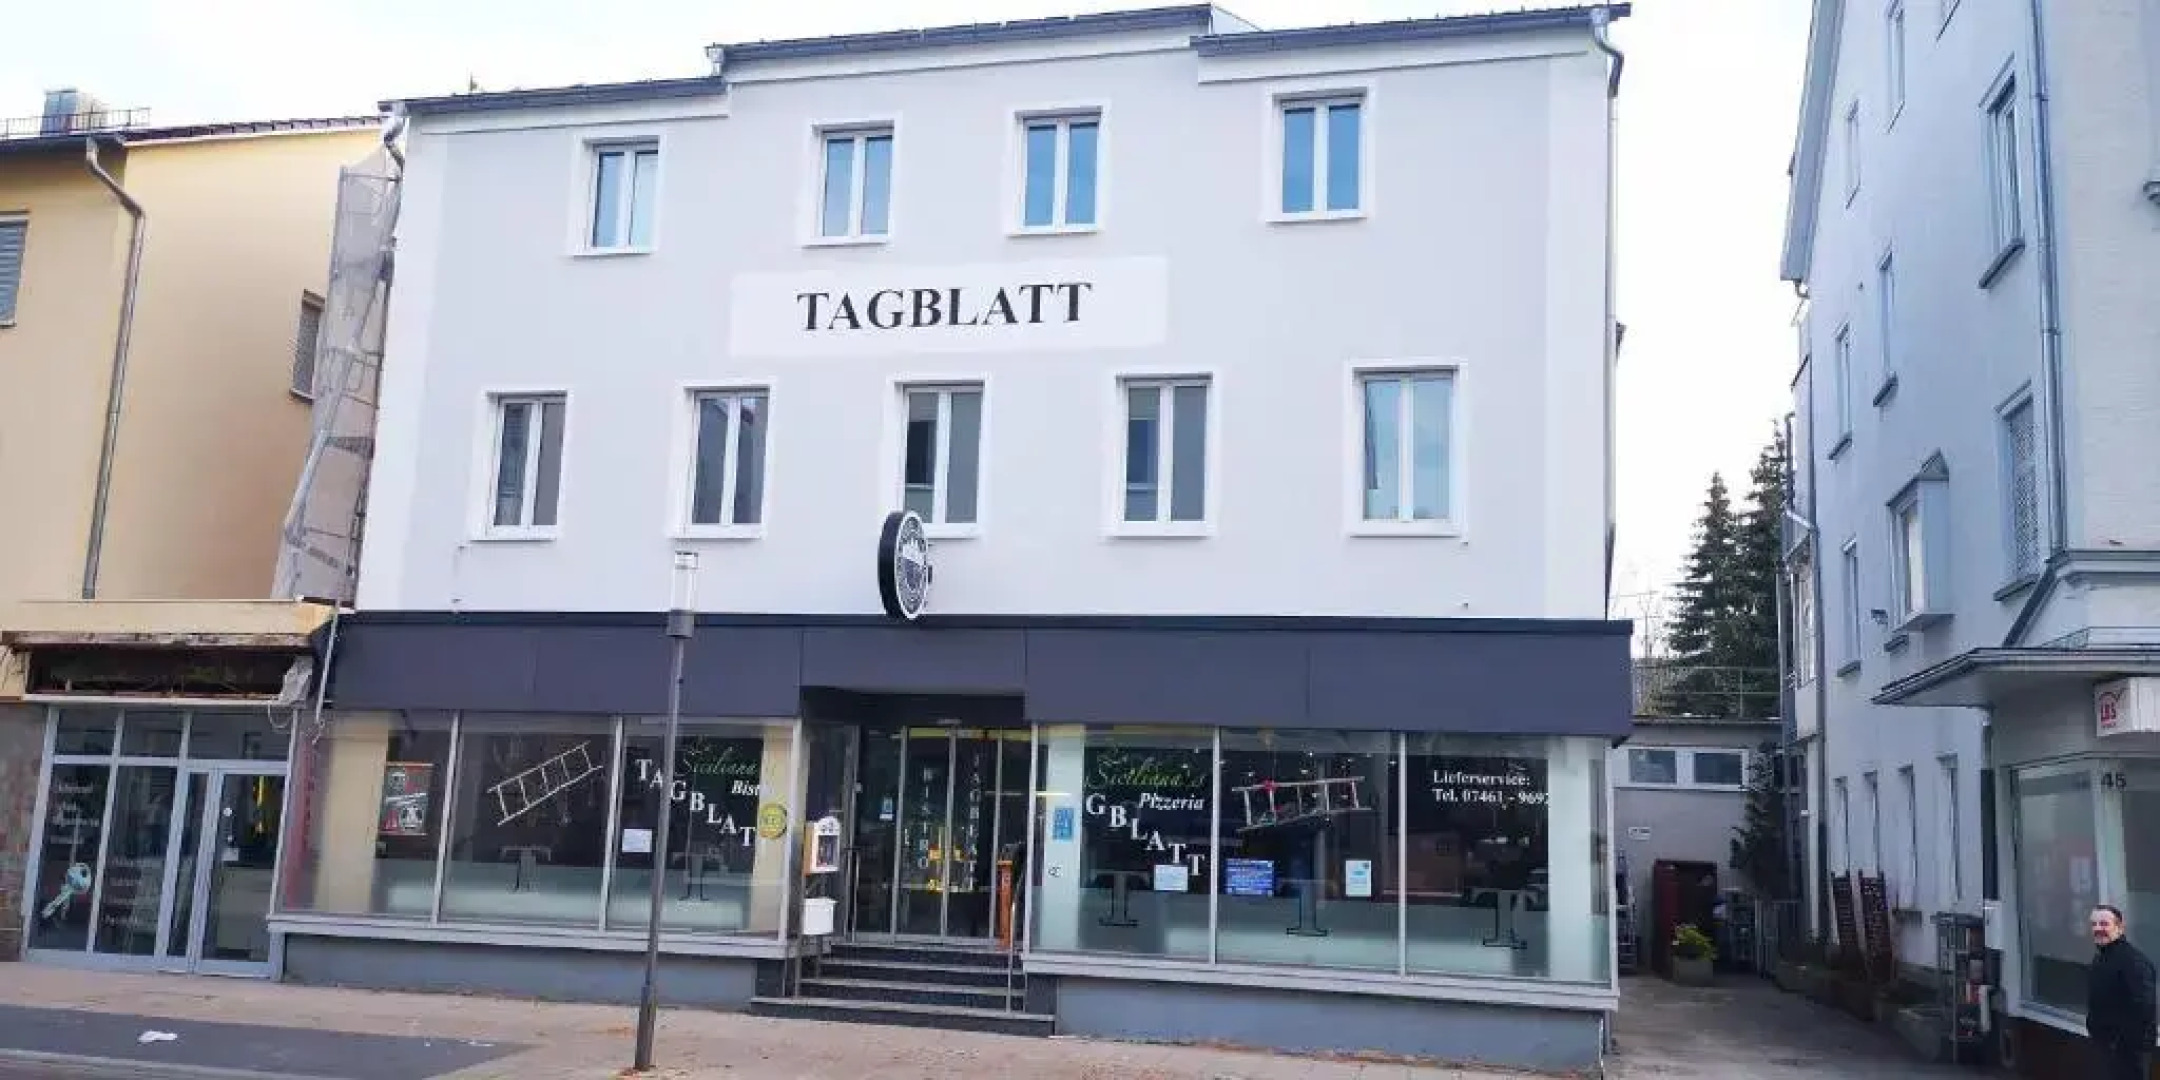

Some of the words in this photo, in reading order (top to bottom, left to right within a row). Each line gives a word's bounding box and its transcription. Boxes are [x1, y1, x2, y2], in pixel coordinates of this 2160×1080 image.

[796, 282, 1093, 331] TAGBLATT
[1433, 769, 1530, 786] Lieferservice:
[1138, 792, 1204, 810] Pizzeria
[1432, 788, 1459, 802] Tel.
